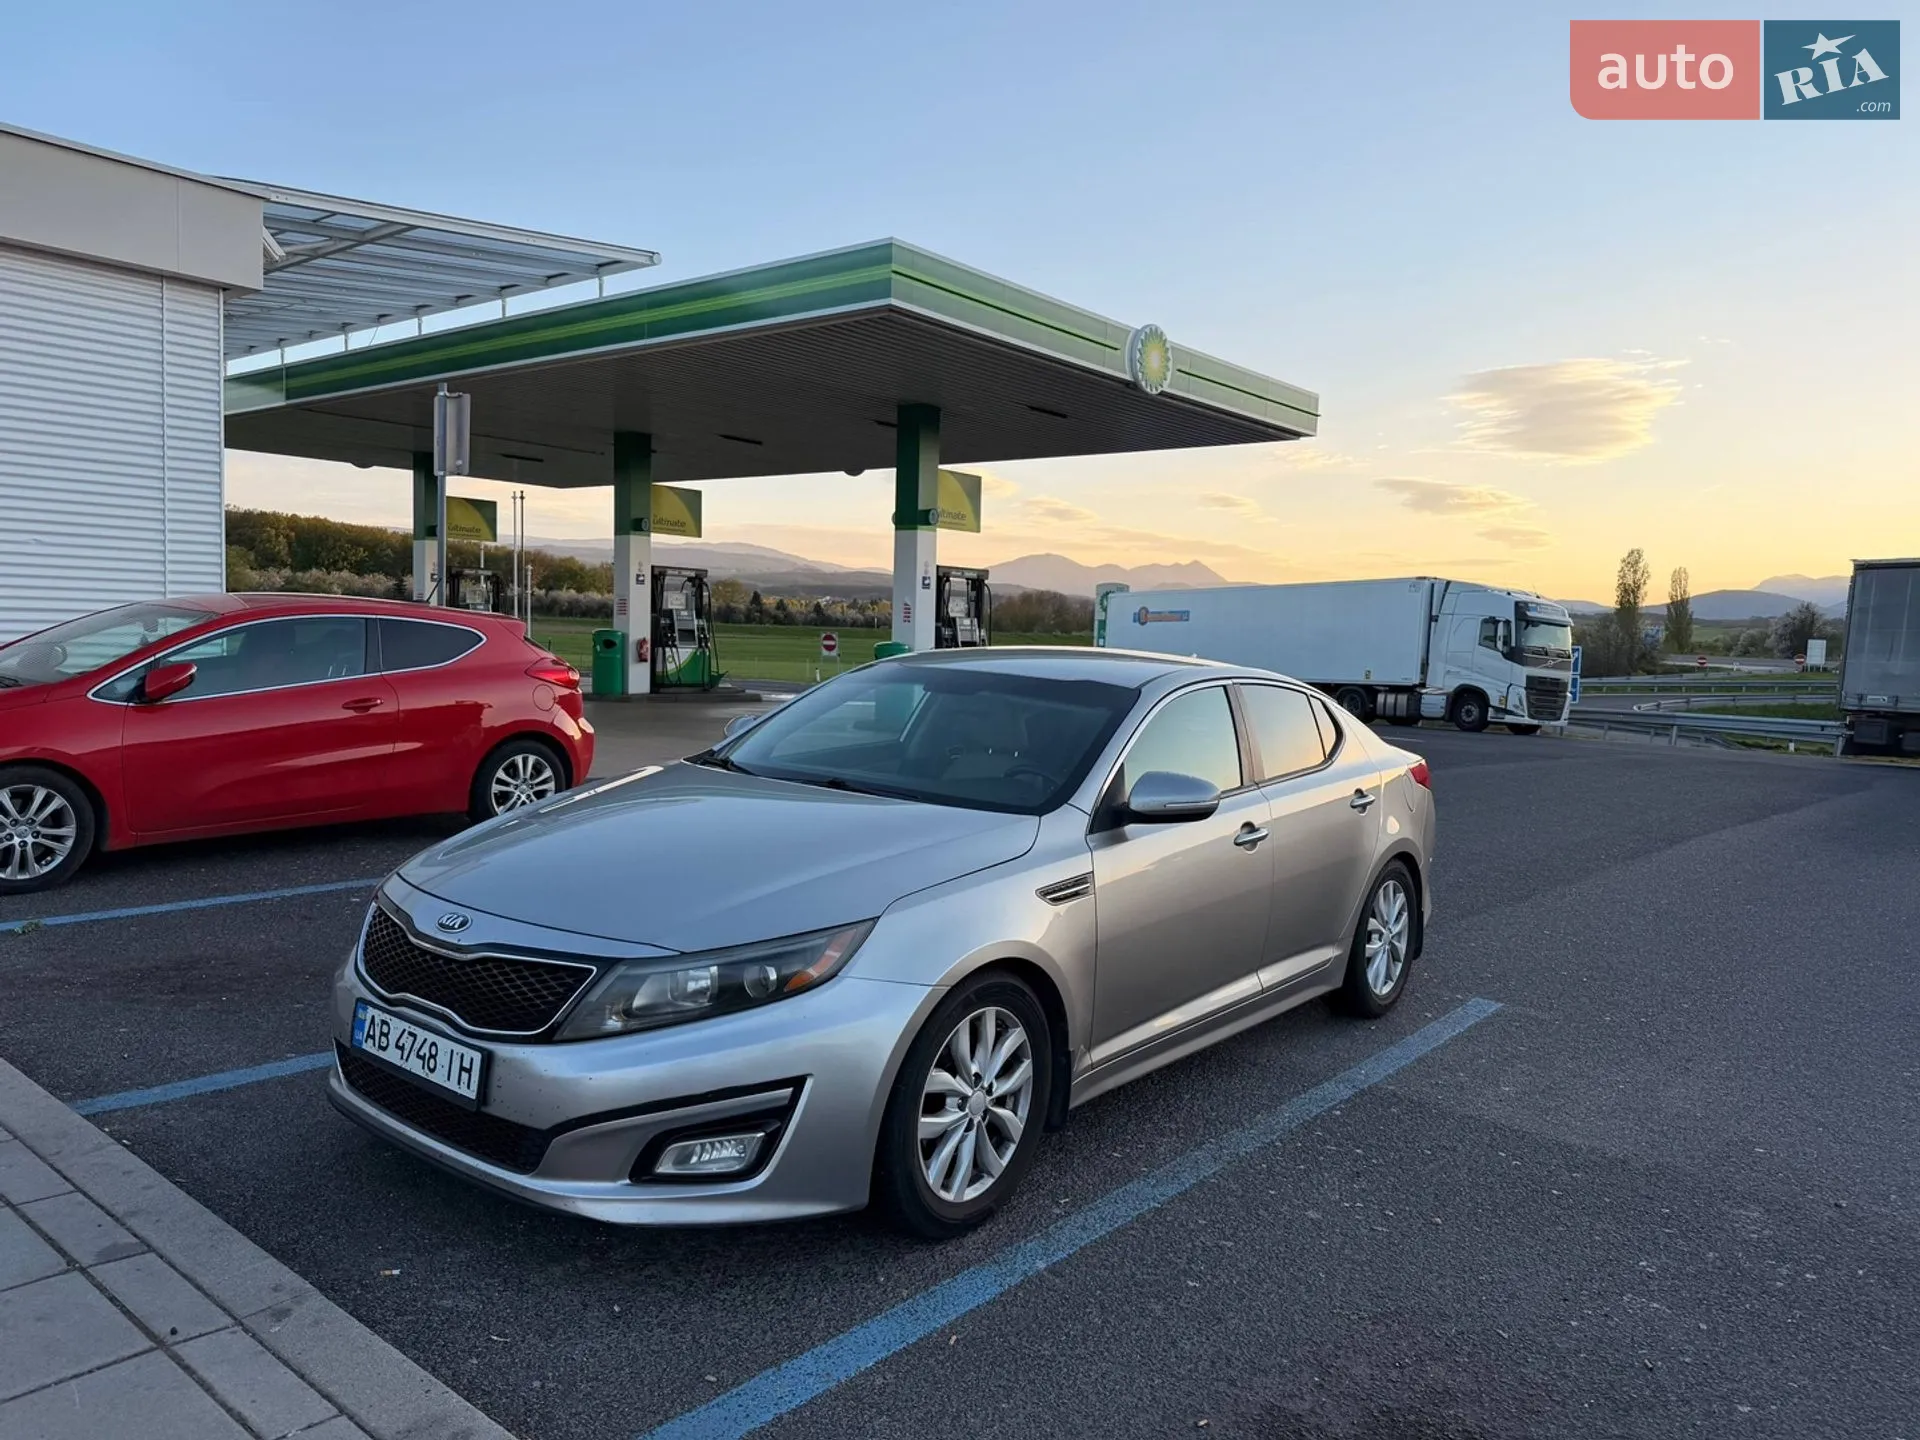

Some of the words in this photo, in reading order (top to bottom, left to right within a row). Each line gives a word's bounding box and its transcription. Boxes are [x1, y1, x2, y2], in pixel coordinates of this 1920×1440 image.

[438, 913, 464, 929] KIA
[364, 1014, 391, 1052] AB
[394, 1028, 439, 1074] 4748
[446, 1048, 474, 1090] IH
